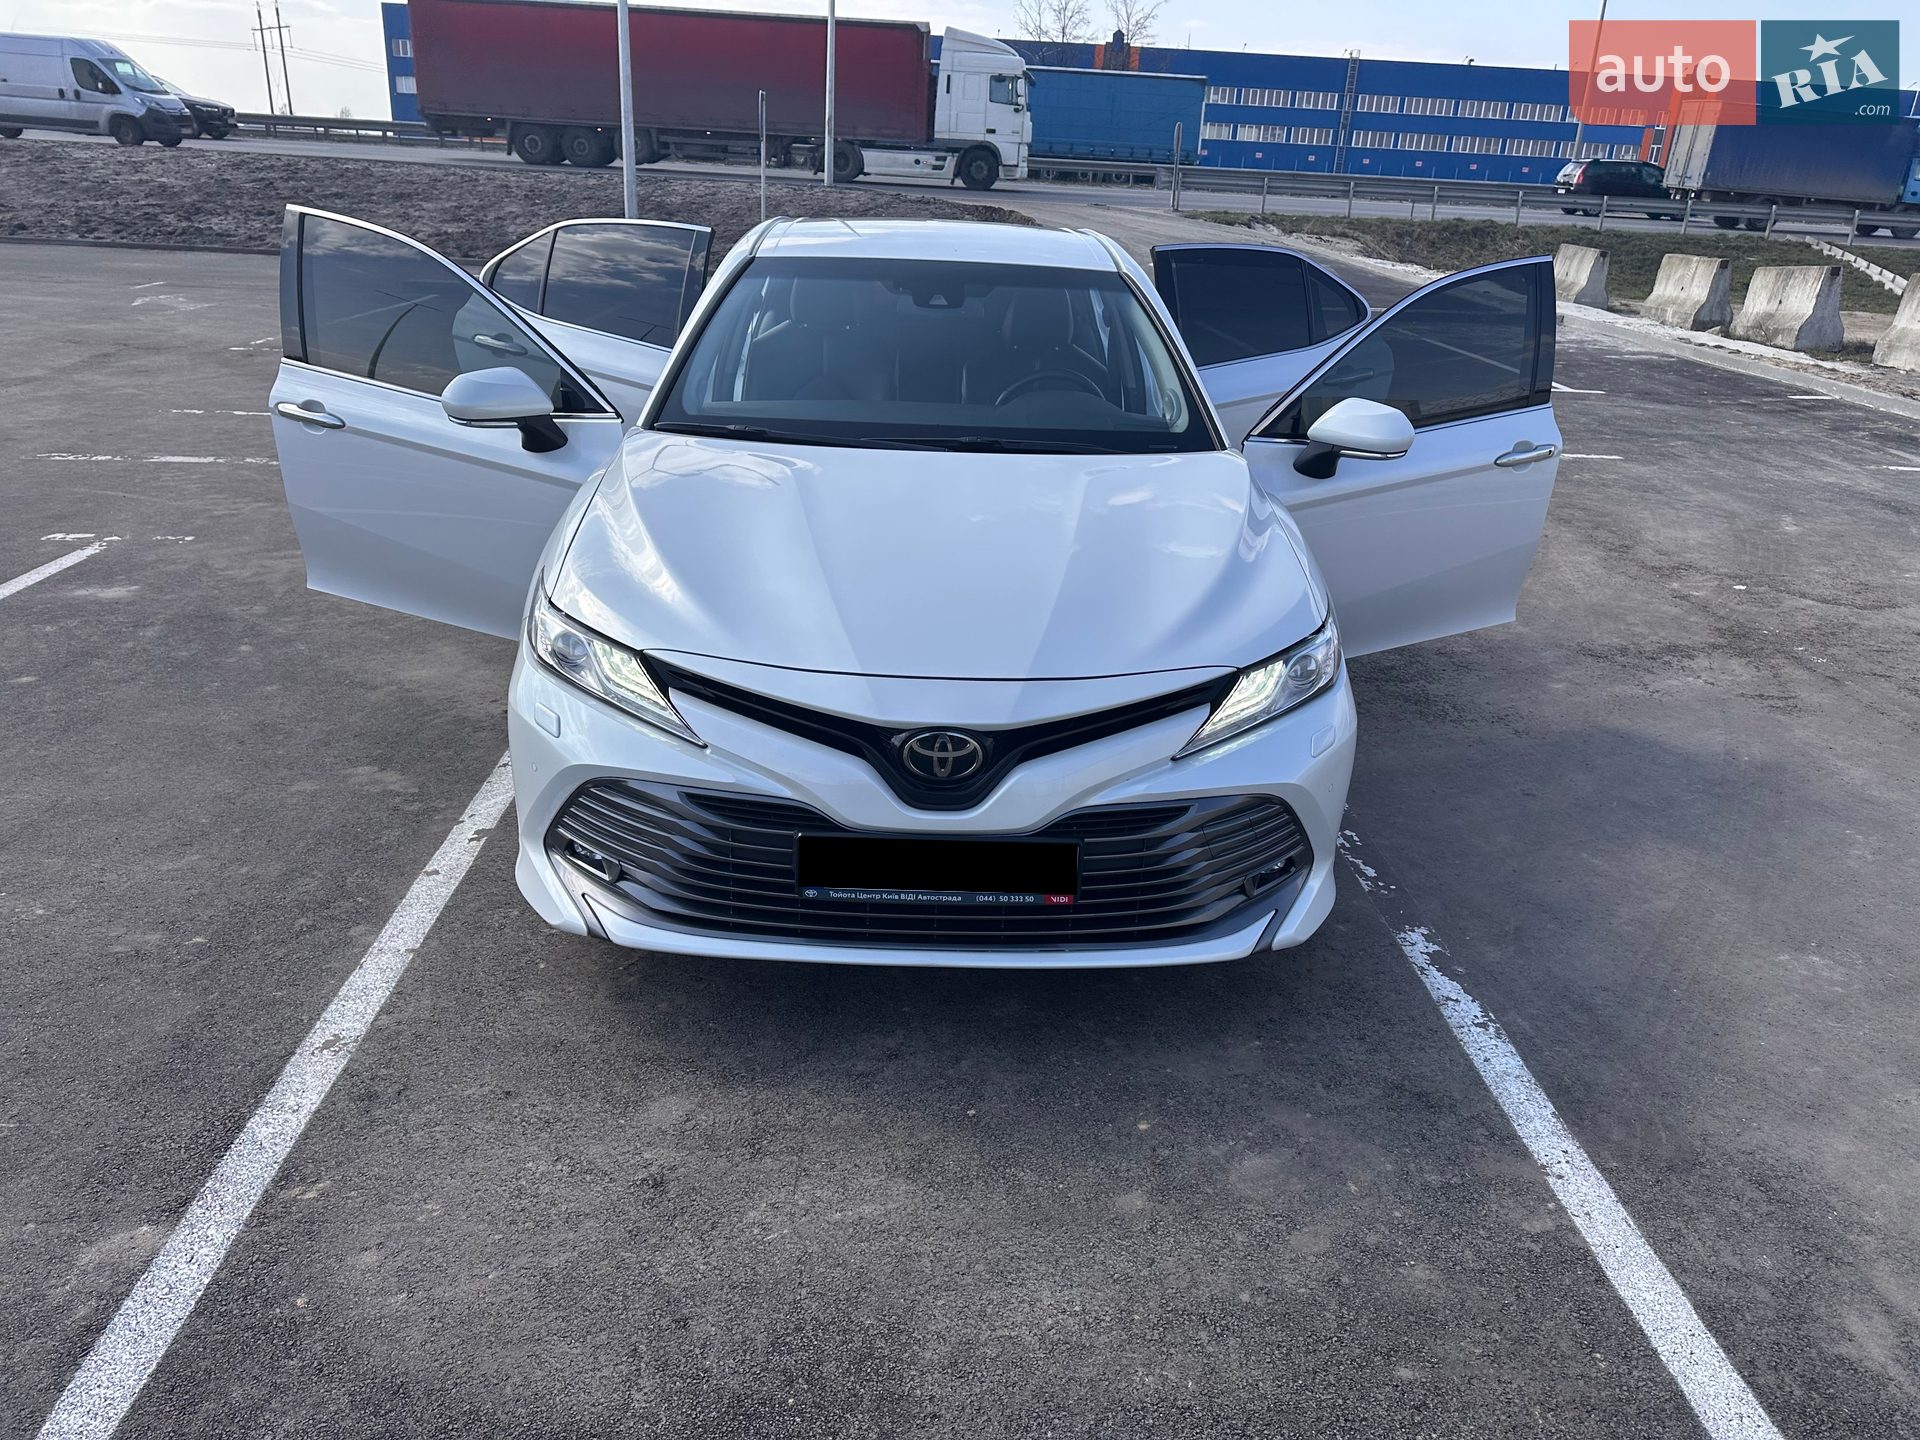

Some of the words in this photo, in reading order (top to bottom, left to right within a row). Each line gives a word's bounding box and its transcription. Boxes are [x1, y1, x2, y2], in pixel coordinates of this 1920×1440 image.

[829, 891, 855, 899] Тойота
[857, 891, 881, 900] Центр
[882, 891, 899, 900] Київ
[917, 893, 962, 902] Автострада
[976, 894, 996, 902] (044)
